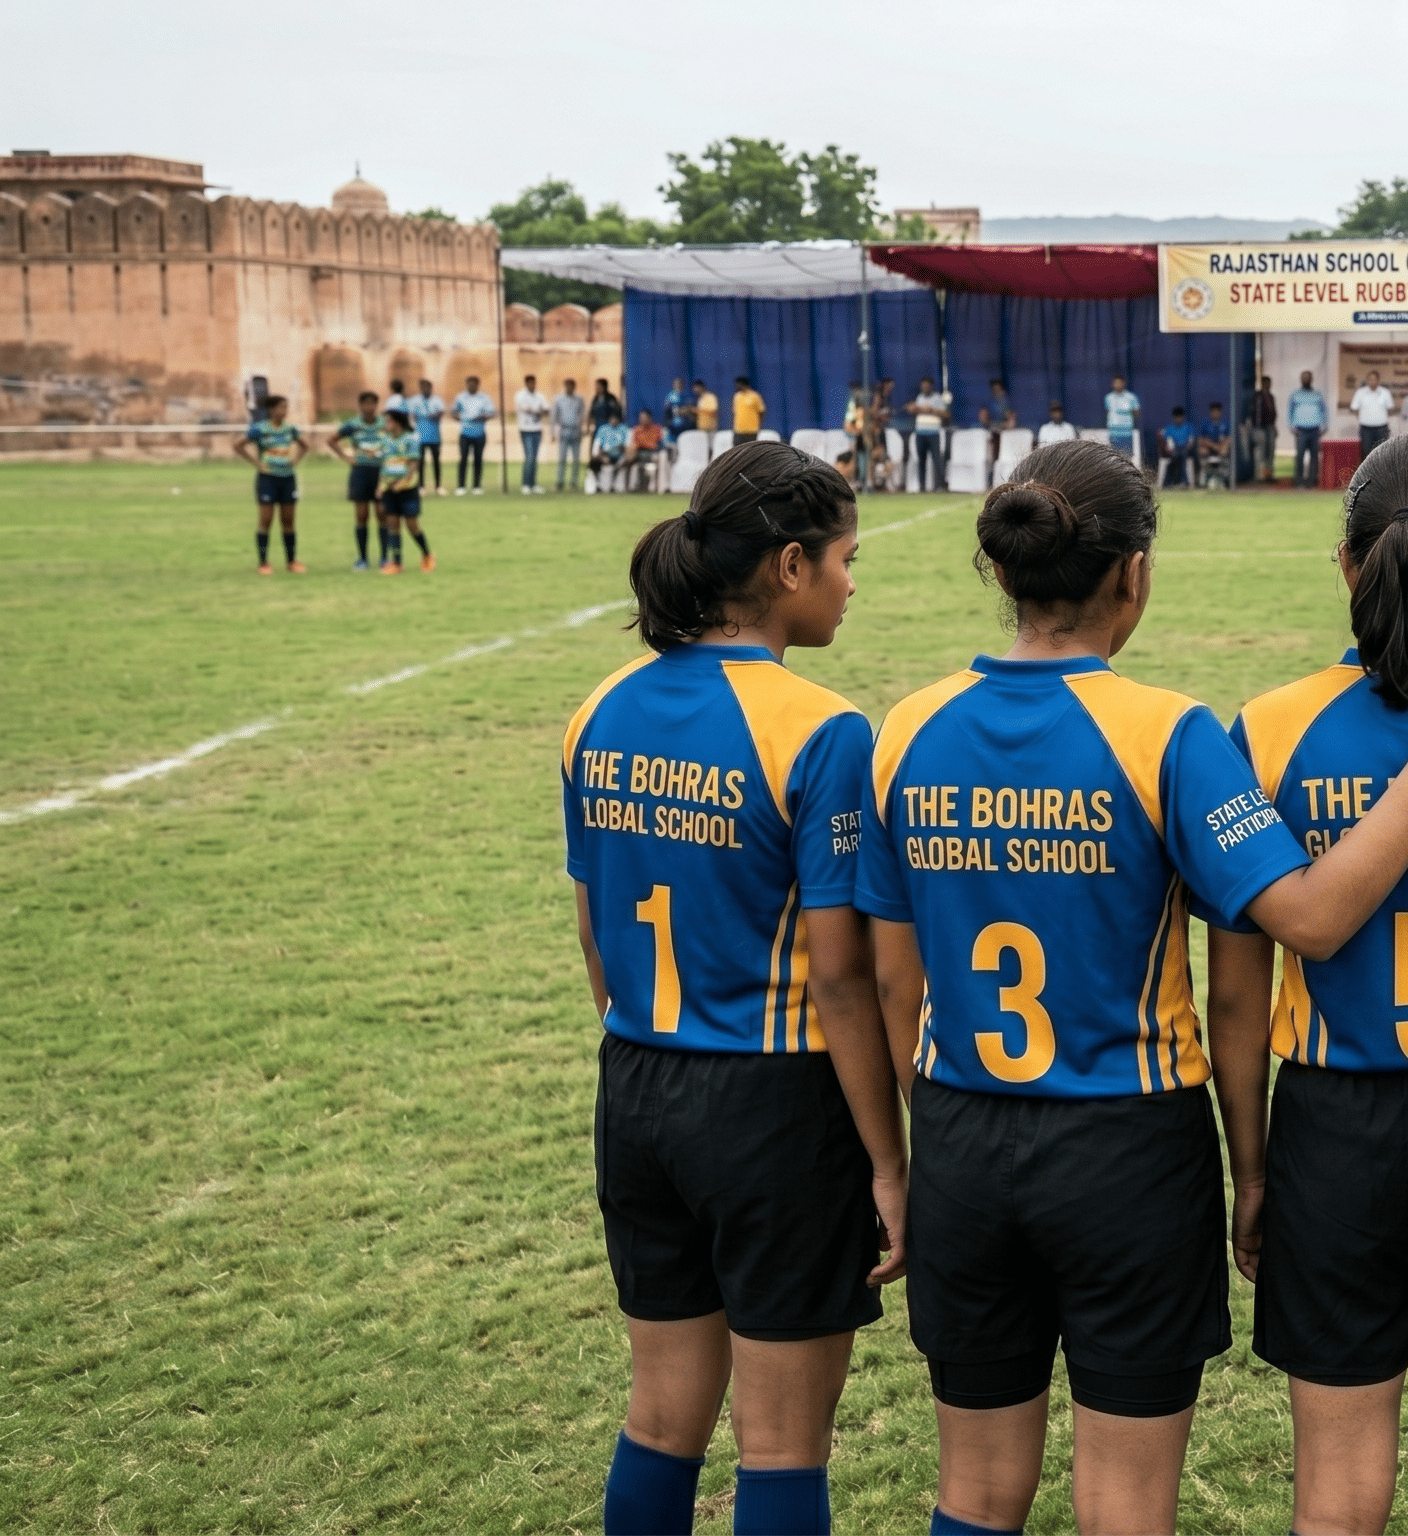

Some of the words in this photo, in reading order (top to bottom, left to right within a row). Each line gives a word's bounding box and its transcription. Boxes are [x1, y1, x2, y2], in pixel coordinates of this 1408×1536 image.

[1210, 253, 1319, 274] RAJASTHAN
[1326, 253, 1399, 273] SCHOOL
[1230, 282, 1287, 304] STATE
[1293, 282, 1349, 303] LEVEL
[582, 750, 624, 791] THE
[630, 754, 746, 810] BOHRAS
[1301, 777, 1373, 821] THE
[654, 805, 743, 849] SCHOOL
[831, 810, 862, 833] STAT
[903, 786, 959, 827] THE
[971, 788, 1113, 832] BOHRAS
[1206, 793, 1253, 831] STATE
[1216, 807, 1282, 853] PARTICIPA
[906, 836, 999, 871] GLOBAL
[1006, 838, 1116, 874] SCHOOL
[636, 884, 681, 1033] 1
[972, 922, 1056, 1083] 3
